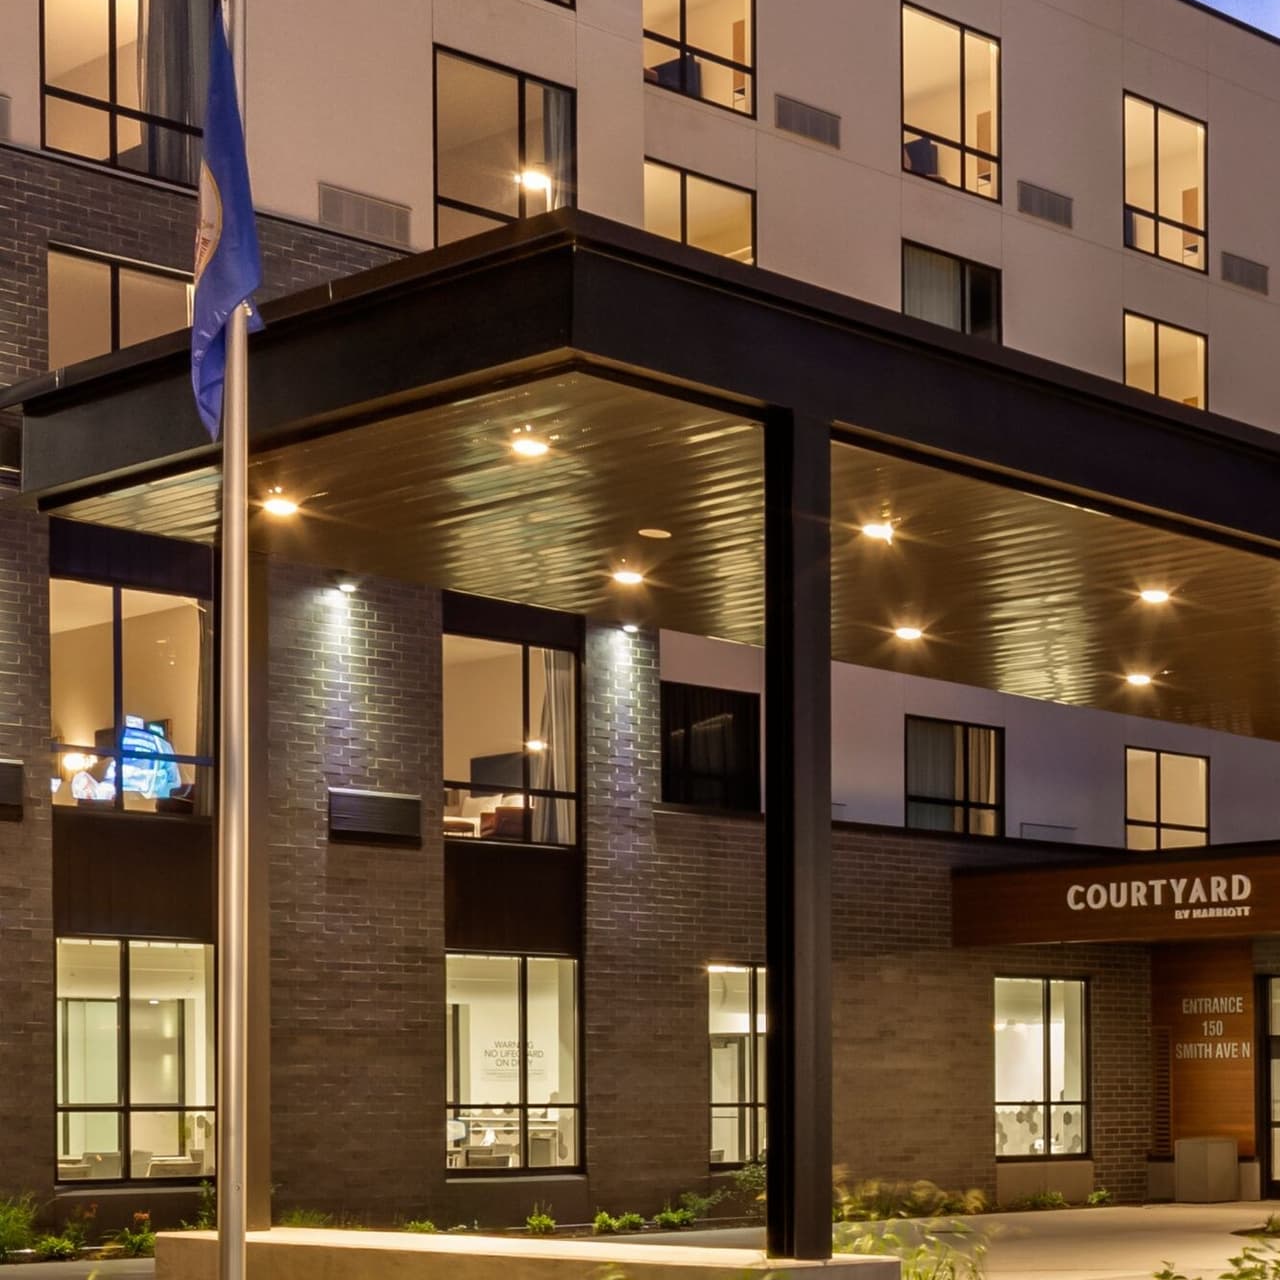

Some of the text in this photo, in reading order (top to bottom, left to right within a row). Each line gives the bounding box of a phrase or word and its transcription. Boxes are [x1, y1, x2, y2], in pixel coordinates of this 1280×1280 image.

[1066, 874, 1251, 911] COURTYARD
[1175, 906, 1251, 920] BY MARRIOTT
[1182, 996, 1244, 1014] ENTRANCE
[1202, 1020, 1224, 1036] 150
[484, 1049, 498, 1058] NO
[1175, 1041, 1250, 1059] SMITH AVE N
[495, 1058, 509, 1067] ON
